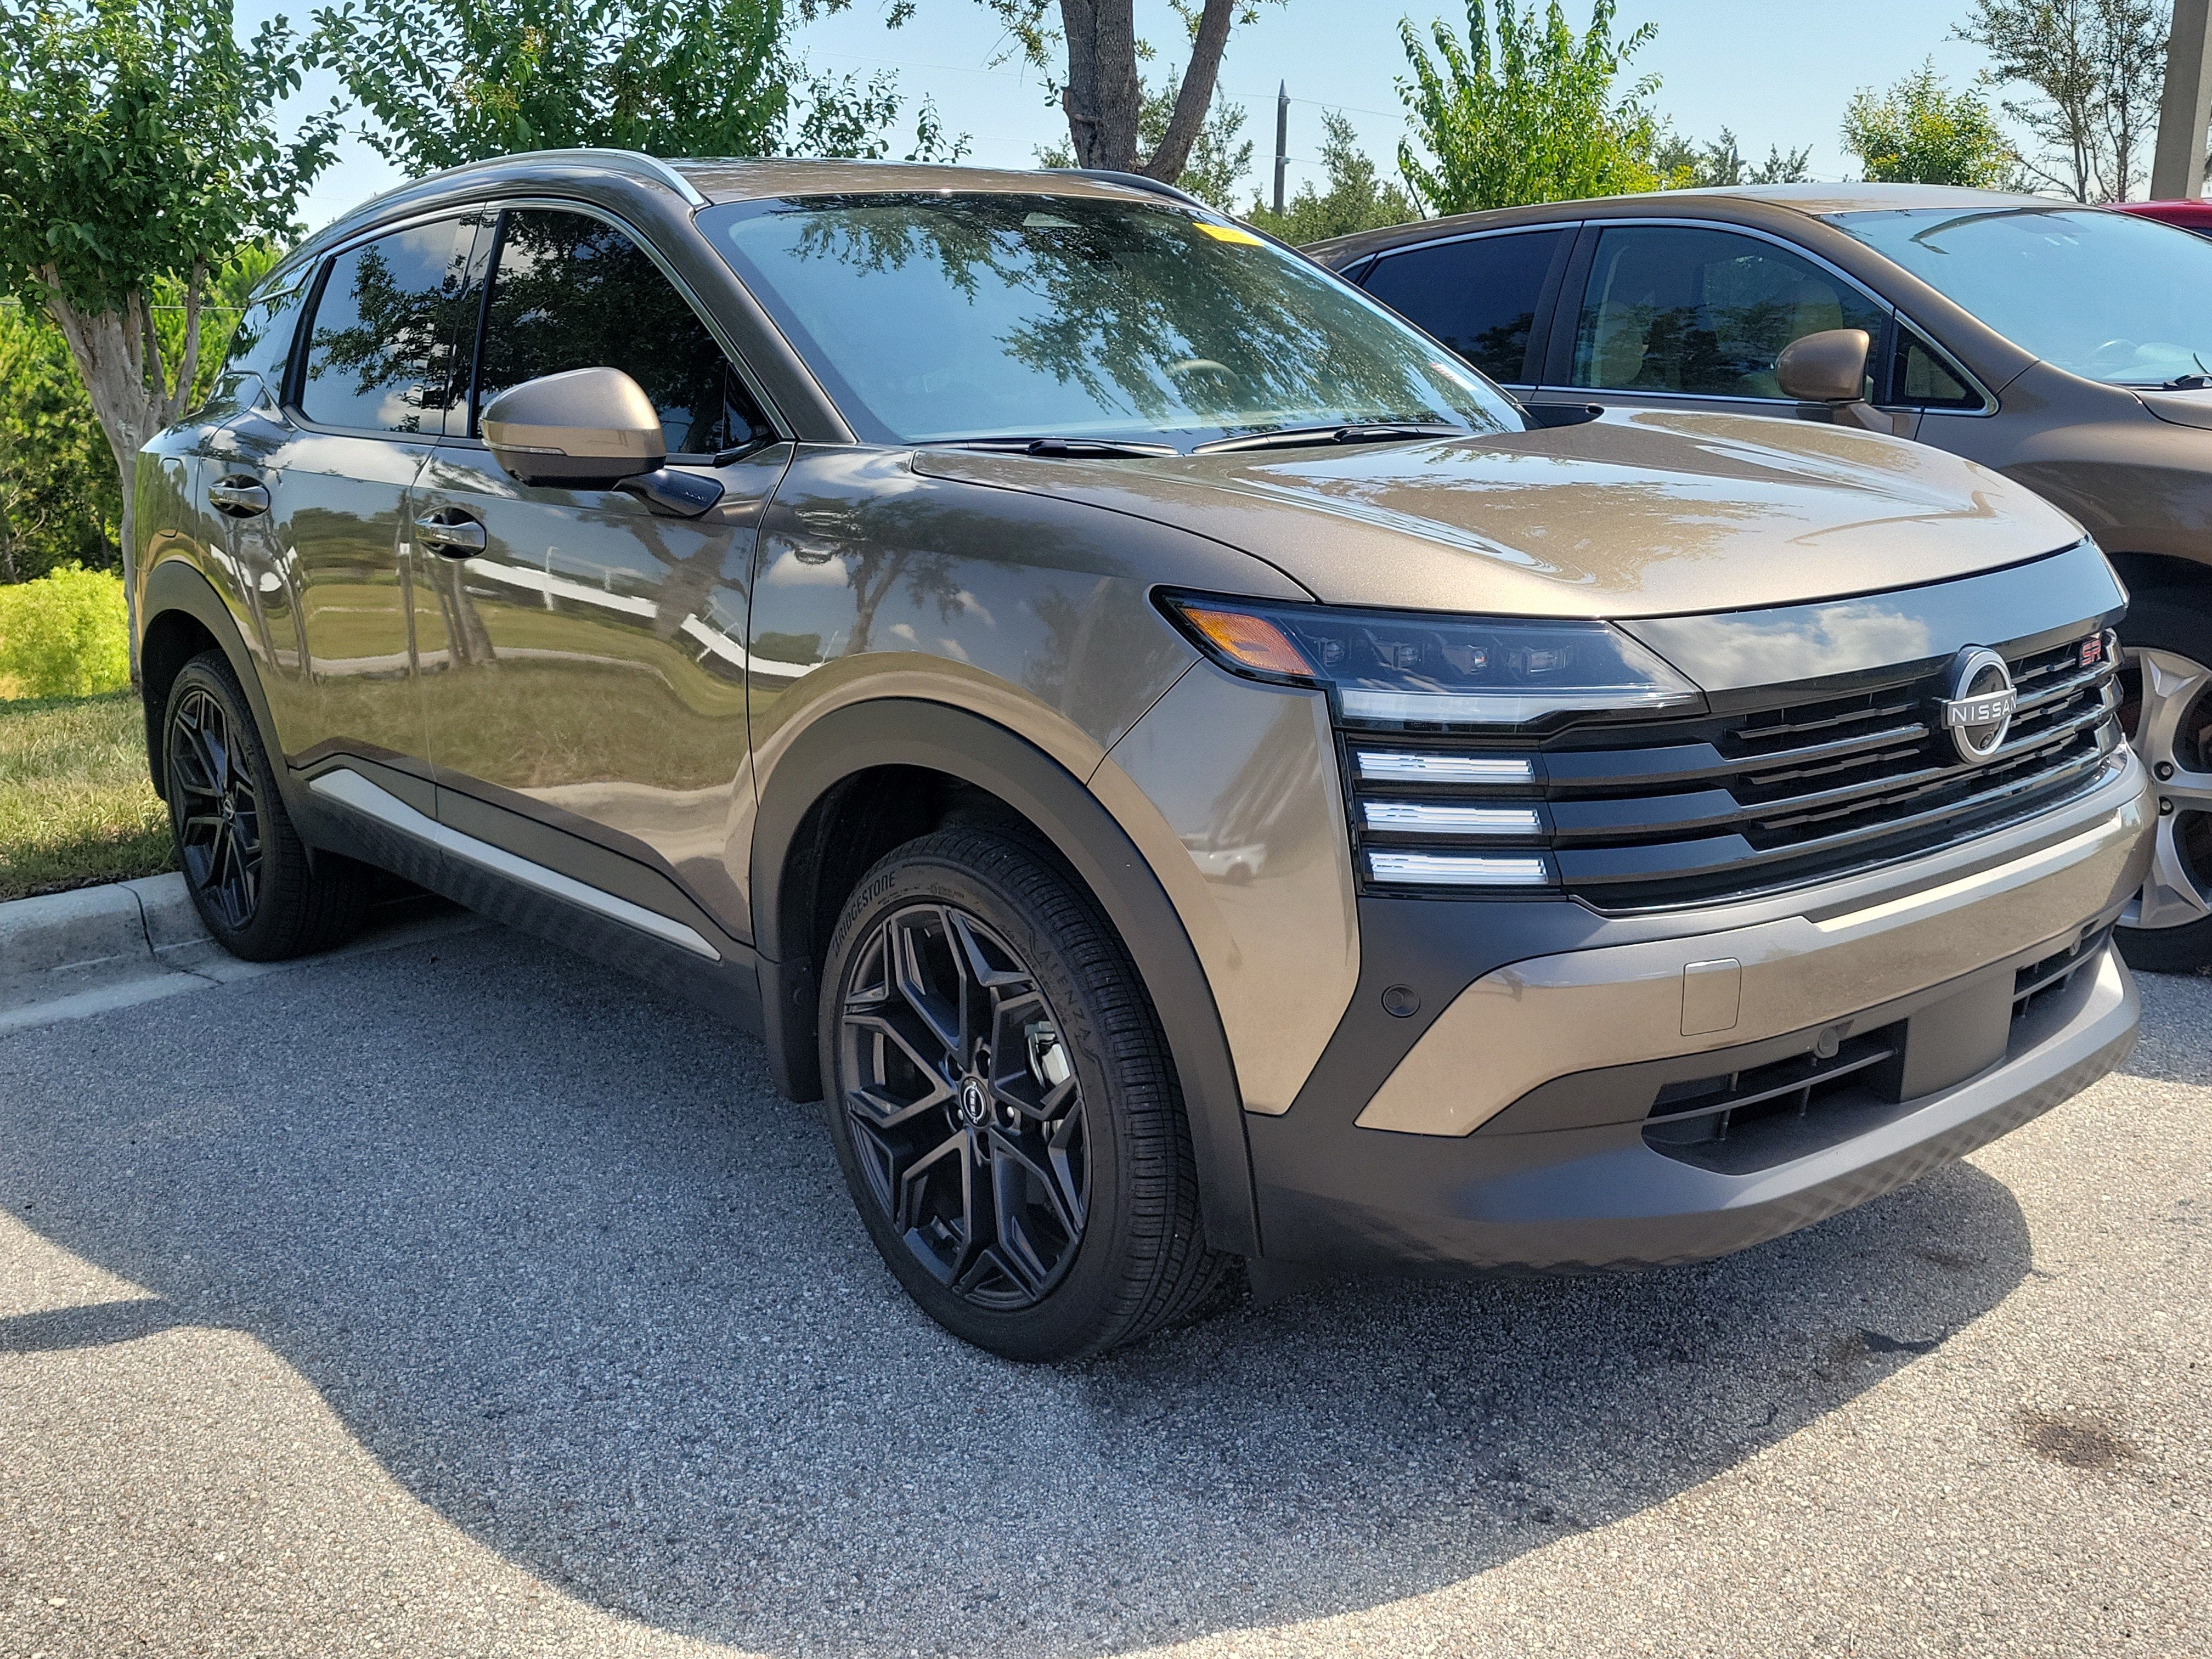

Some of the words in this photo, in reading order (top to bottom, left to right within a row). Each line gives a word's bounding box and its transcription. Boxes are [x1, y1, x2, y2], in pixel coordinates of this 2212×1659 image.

[2081, 640, 2101, 665] SR
[1952, 693, 2017, 723] NISSAN
[831, 871, 896, 958] BRIDGESTONE
[1040, 950, 1092, 1041] ALENZA
